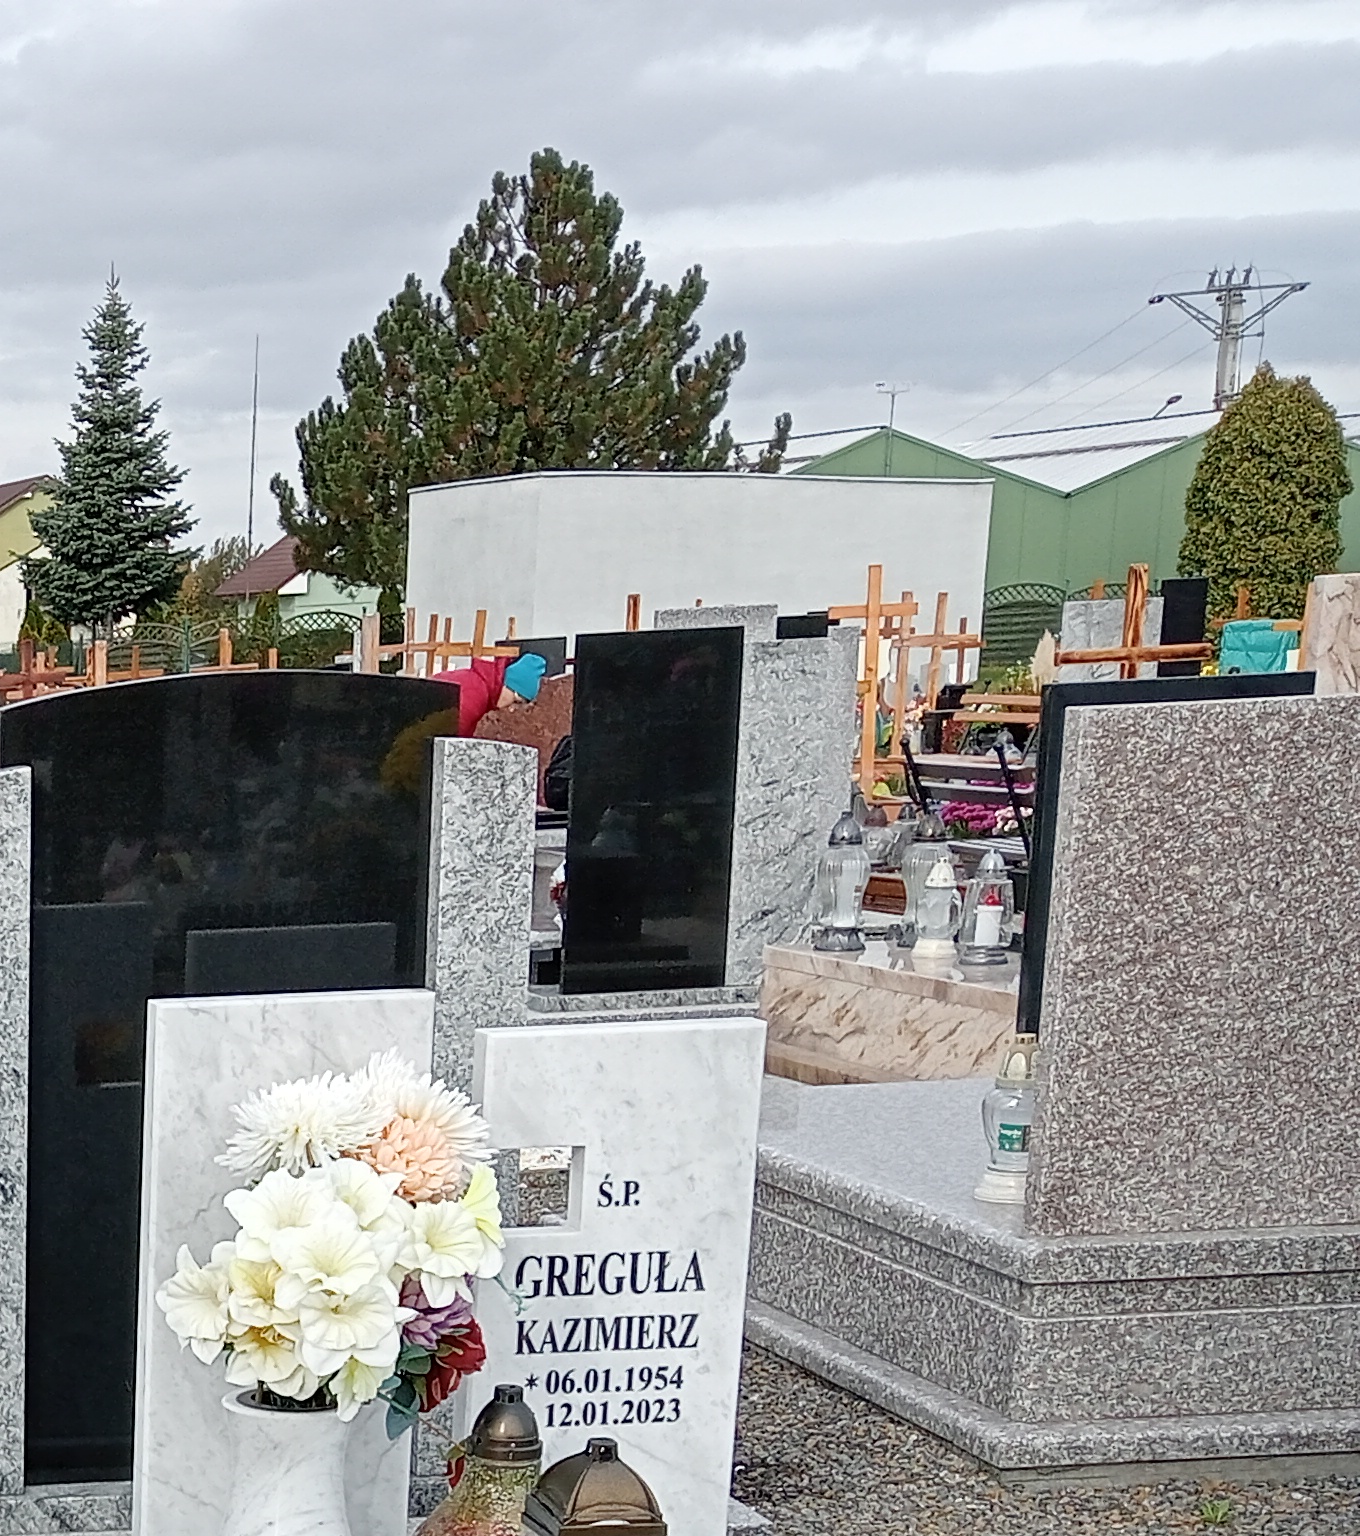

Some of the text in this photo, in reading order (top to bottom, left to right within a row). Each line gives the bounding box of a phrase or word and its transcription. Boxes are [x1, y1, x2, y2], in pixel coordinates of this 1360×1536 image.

[597, 1173, 640, 1208] Ś.P.
[515, 1250, 705, 1299] GREGUŁA
[515, 1311, 699, 1355] KAZIMIERZ
[544, 1397, 681, 1428] 12.01.2023
